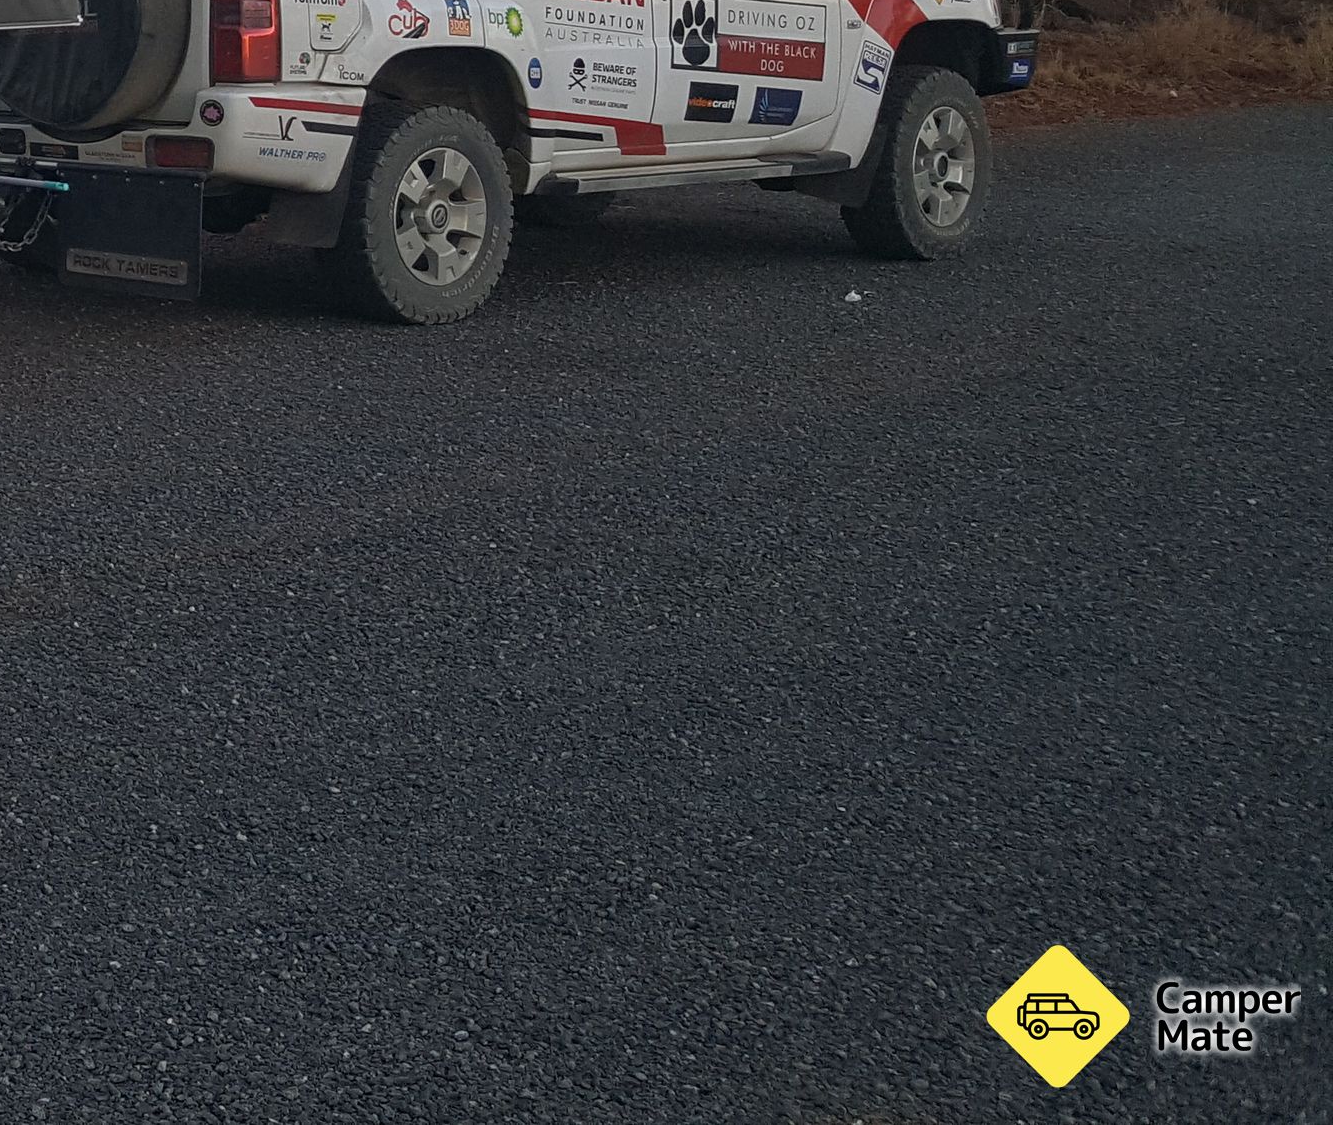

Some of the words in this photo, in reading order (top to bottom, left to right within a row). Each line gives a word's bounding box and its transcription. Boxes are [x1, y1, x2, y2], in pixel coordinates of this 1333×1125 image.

[487, 8, 504, 28] bp
[545, 6, 644, 30] FOUNDATION
[727, 9, 788, 29] DRIVING
[796, 16, 815, 31] OZ
[545, 27, 645, 49] AUSTRALIA
[727, 39, 756, 53] WITH
[760, 42, 780, 56] THE
[784, 44, 817, 59] BLACK
[592, 62, 625, 75] BEWARE
[625, 66, 637, 76] OF
[760, 59, 784, 72] DOG
[592, 74, 637, 88] STRANGERS
[259, 146, 303, 160] WALTHER
[73, 254, 110, 271] ROCK
[117, 259, 179, 278] TAMERS
